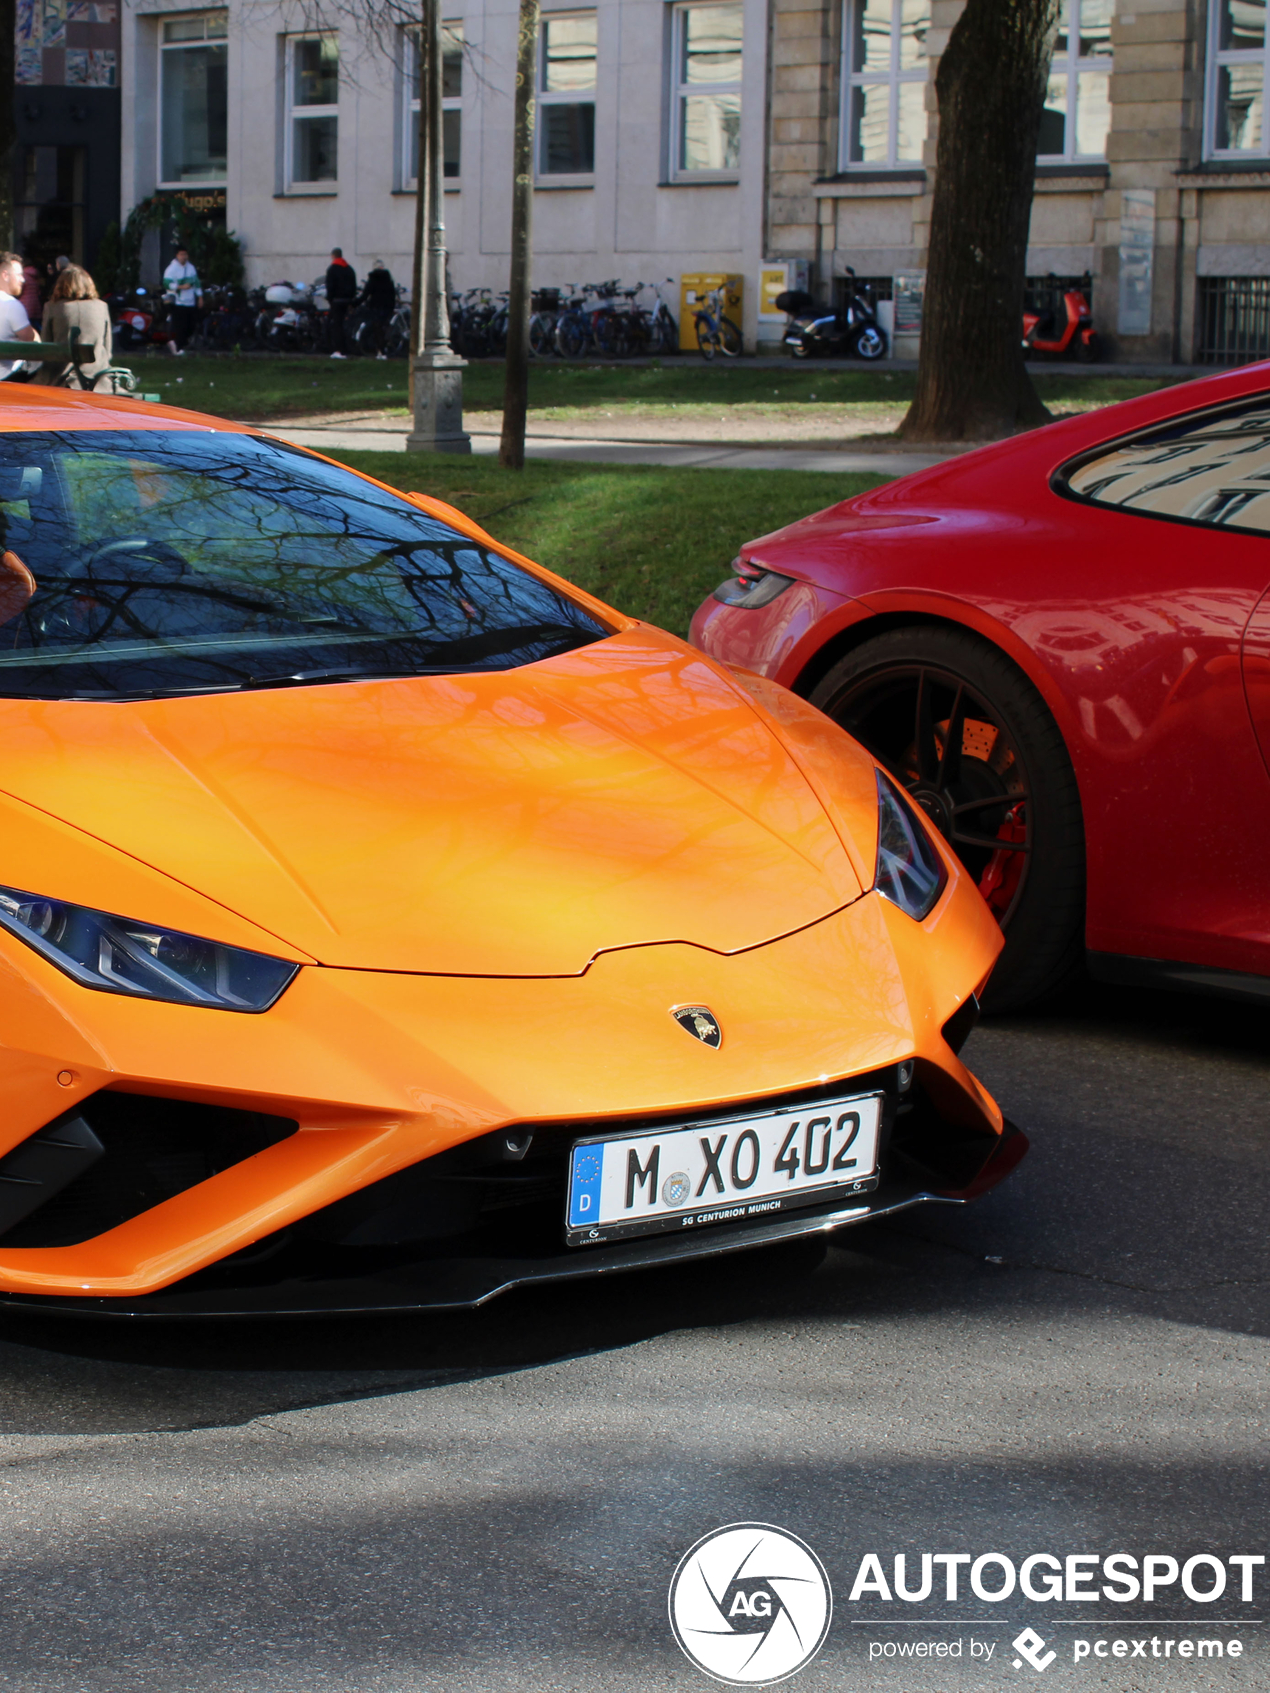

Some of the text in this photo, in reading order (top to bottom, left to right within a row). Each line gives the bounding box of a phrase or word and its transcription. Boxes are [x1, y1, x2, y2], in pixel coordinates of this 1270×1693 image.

[625, 1145, 660, 1209] M
[696, 1129, 761, 1197] XO
[774, 1111, 861, 1180] 402
[580, 1194, 591, 1212] D
[682, 1200, 781, 1226] SG CENTURION MUNICH
